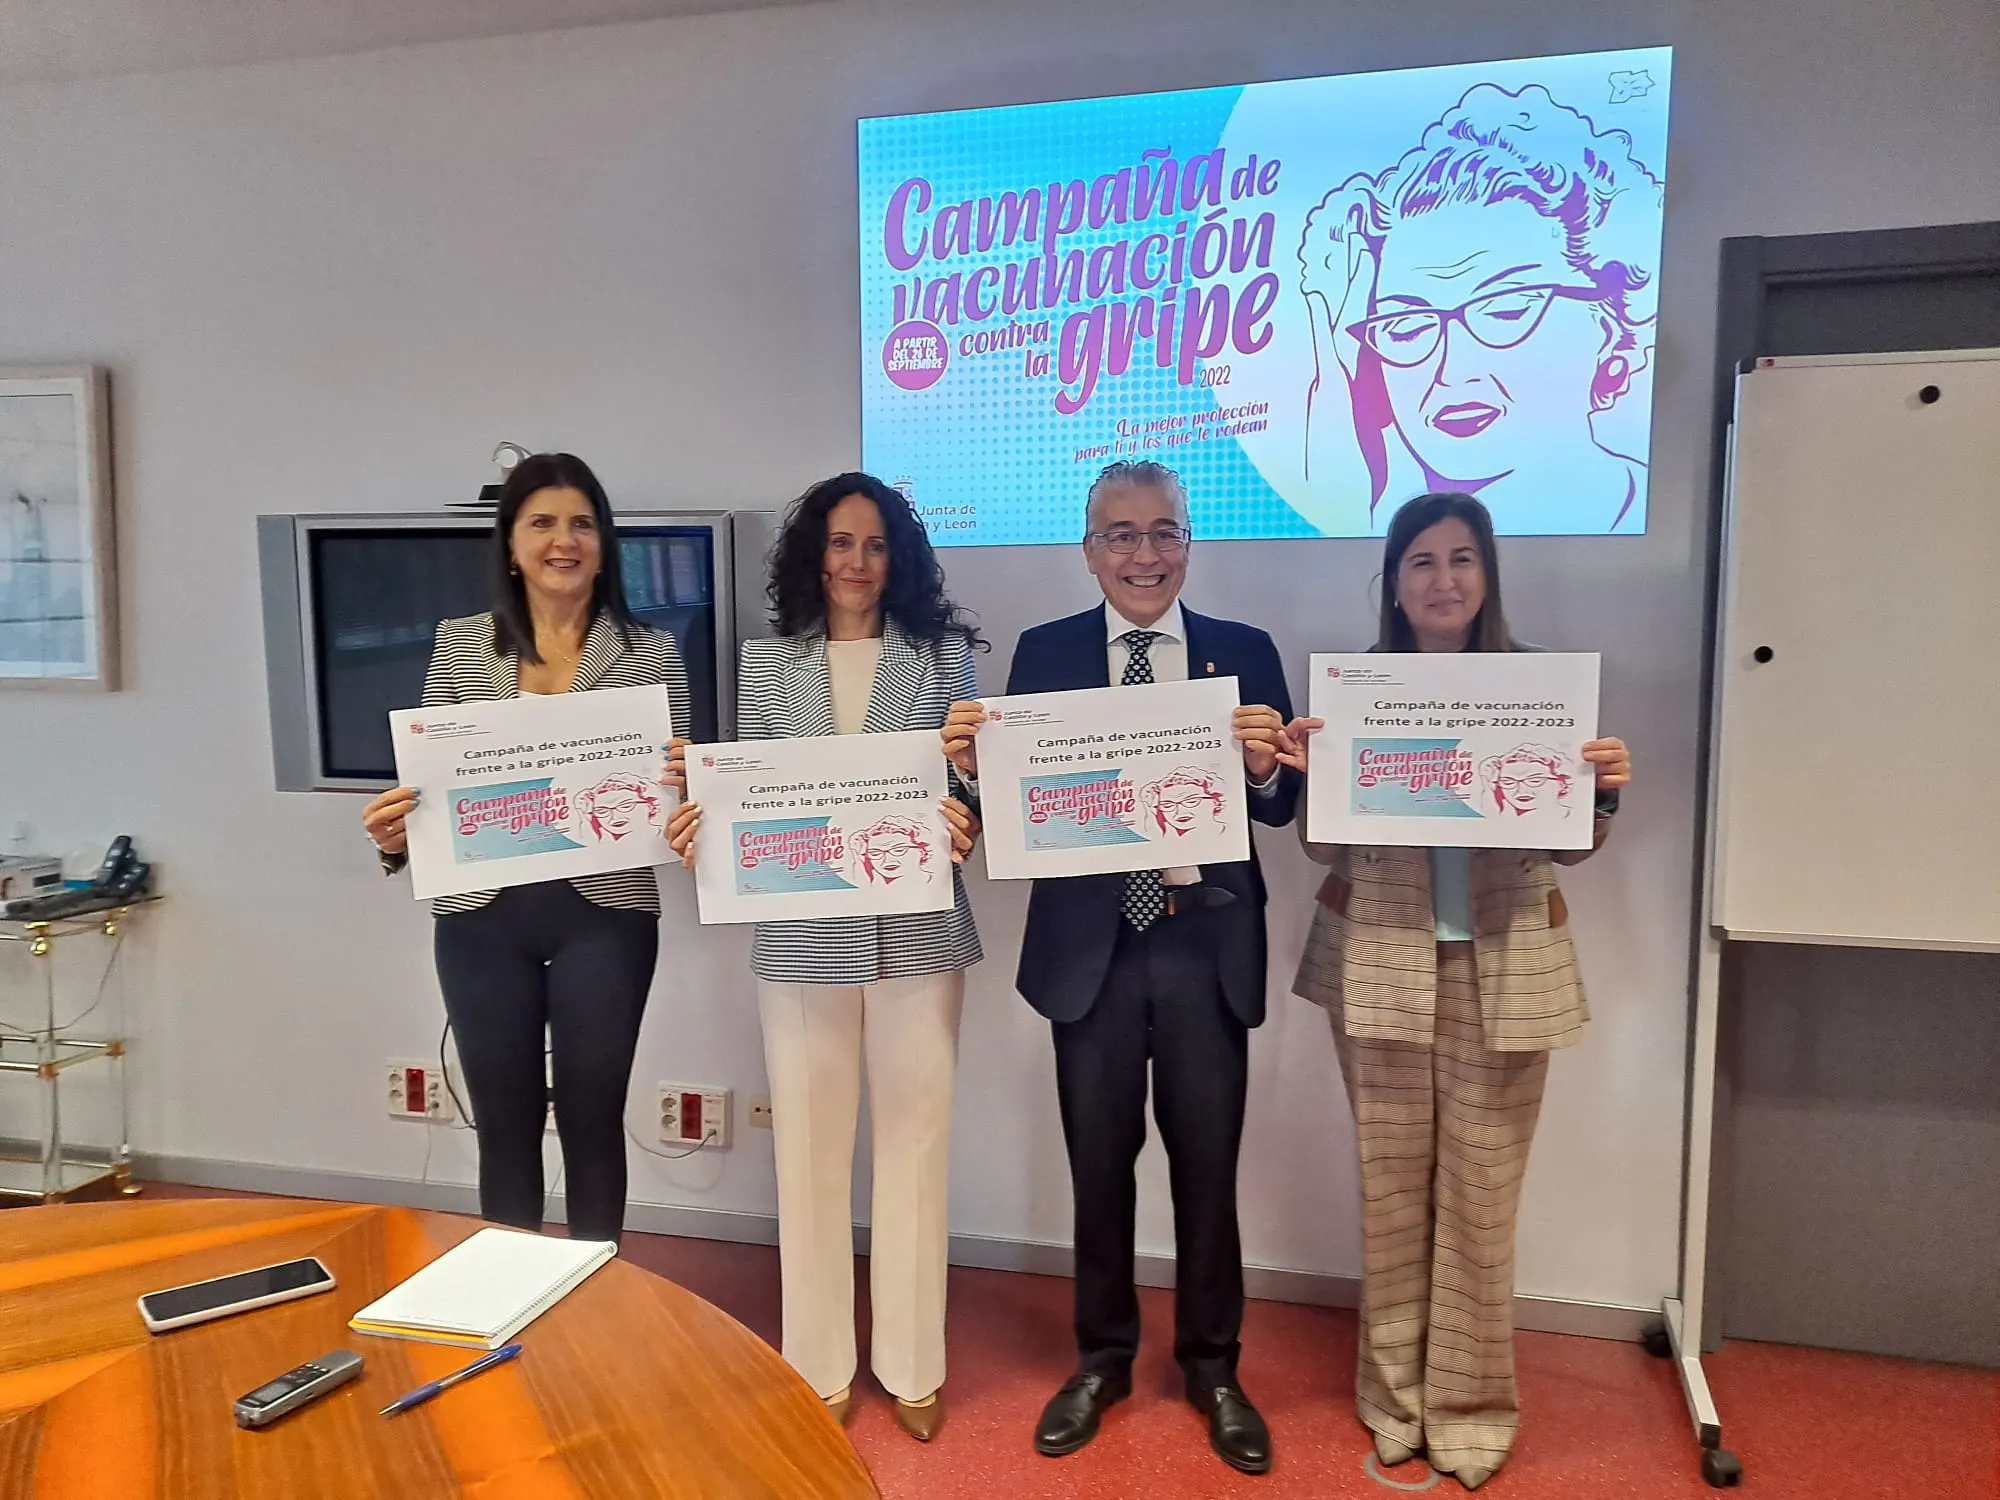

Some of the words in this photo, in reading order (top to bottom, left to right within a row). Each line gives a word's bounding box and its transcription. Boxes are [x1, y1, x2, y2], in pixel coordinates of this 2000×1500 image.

[884, 145, 1226, 271] Campaña
[1230, 154, 1281, 199] de
[893, 208, 1275, 326] vacunación
[893, 338, 901, 349] A
[903, 336, 938, 349] PARTIR
[959, 318, 1050, 357] contra
[1054, 272, 1280, 416] gripe
[887, 357, 944, 371] SEPTIEMBRE
[1024, 350, 1049, 378] la
[1199, 365, 1232, 389] 2022
[1116, 418, 1140, 438] La
[1145, 409, 1188, 433] mejor
[1192, 400, 1269, 428] protección
[1074, 442, 1109, 464] para
[1128, 440, 1137, 457] y
[1142, 434, 1161, 450] los
[1167, 430, 1192, 448] que
[1215, 418, 1268, 439] rodean
[920, 505, 957, 516] Junta
[960, 504, 977, 515] de
[932, 521, 941, 533] y
[1374, 700, 1446, 713] Campaña
[1450, 700, 1471, 711] de
[1474, 700, 1565, 711] vacunación
[1363, 715, 1412, 727] frente
[1415, 719, 1424, 727] a
[1428, 715, 1442, 727] la
[1446, 716, 1487, 730] gripe
[1491, 716, 1575, 728] 2022-2023
[463, 744, 534, 761] Campaña
[538, 741, 557, 752] de
[561, 731, 643, 749] vacunación
[1037, 734, 1105, 749] Campaña
[1108, 732, 1126, 743] de
[1129, 724, 1212, 740] vacunación
[455, 763, 502, 778] frente
[506, 763, 516, 772] a
[519, 760, 533, 771] la
[536, 756, 575, 770] gripe
[578, 745, 654, 763] 2022-2023
[1029, 752, 1073, 766] frente
[1077, 753, 1086, 761] a
[1089, 749, 1102, 760] la
[1106, 746, 1143, 760] gripe
[1147, 739, 1223, 755] 2022-2023
[749, 782, 815, 796] Campaña
[818, 780, 836, 790] de
[839, 775, 919, 788] vacunación
[1028, 778, 1120, 803] Campaña
[1409, 771, 1474, 794] gripe
[740, 800, 784, 811] frente
[800, 797, 813, 807] la
[816, 795, 852, 806] gripe
[855, 789, 929, 804] 2022-2023
[1077, 798, 1136, 826] gripe
[510, 805, 570, 836] gripe
[787, 845, 845, 872] gripe
